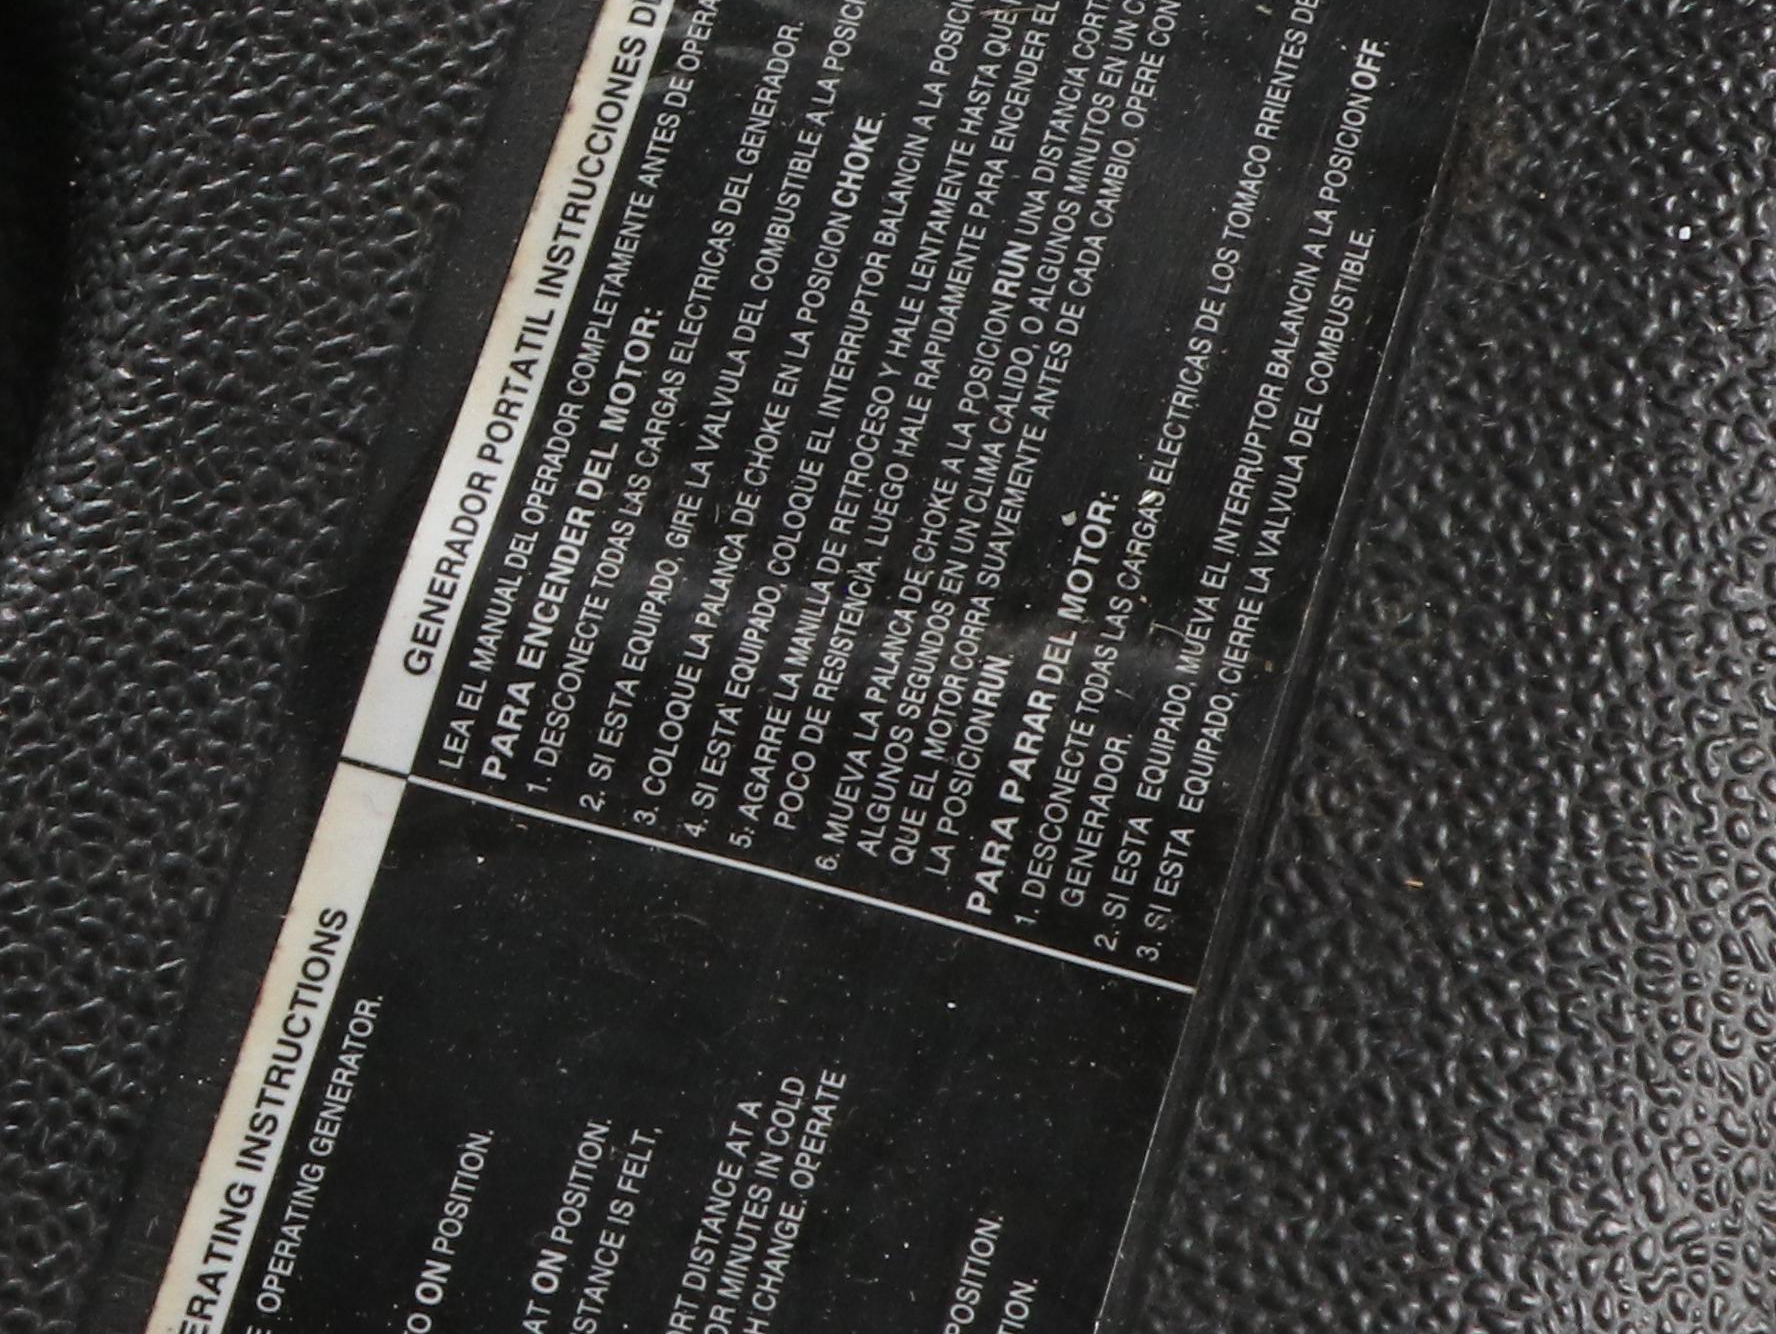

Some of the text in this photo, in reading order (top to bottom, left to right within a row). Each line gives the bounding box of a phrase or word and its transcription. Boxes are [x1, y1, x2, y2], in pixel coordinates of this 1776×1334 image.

[637, 112, 680, 188] ANTES
[662, 75, 694, 108] DE
[566, 190, 654, 396] COMPLETAMENTE
[402, 471, 497, 676] GENERADOR
[475, 308, 555, 464] PORTATIL
[533, 35, 647, 298] INSTRUCCIONES
[520, 401, 584, 525] OPERADOR
[480, 306, 663, 780] PARA ENCENDER DEL MOTOR:
[503, 531, 539, 570] DEL
[468, 575, 523, 671] MANUAL
[437, 719, 475, 769] LEA
[455, 679, 487, 711] EL
[965, 490, 1119, 915] PARA PARAR DEL MOTOR:
[1059, 733, 1133, 907] GENERADOR.
[234, 907, 348, 1172] INSTRUCTIONS
